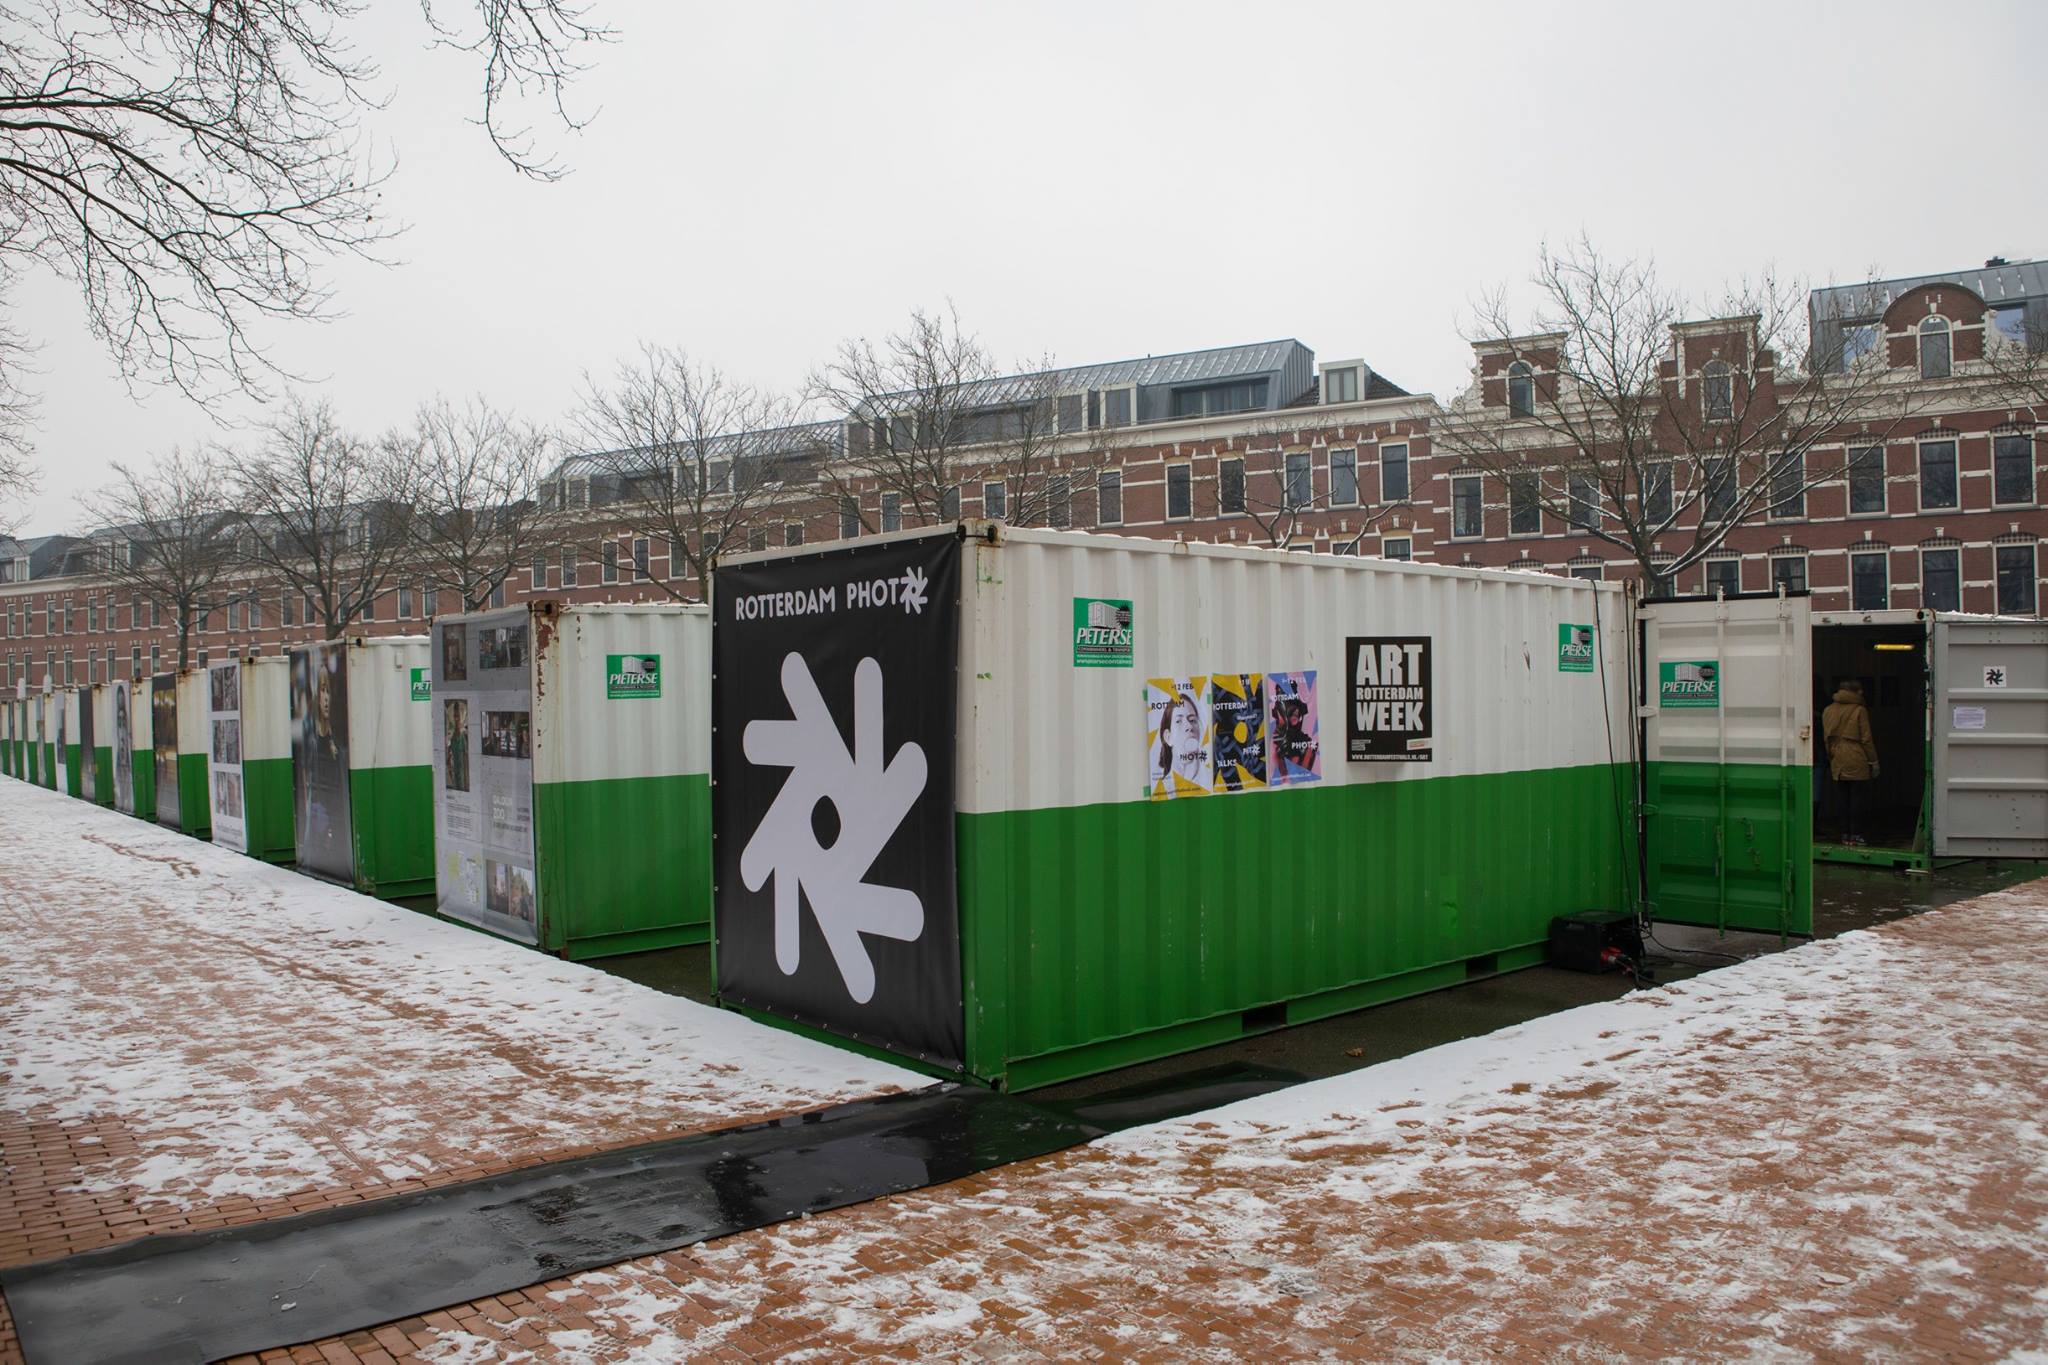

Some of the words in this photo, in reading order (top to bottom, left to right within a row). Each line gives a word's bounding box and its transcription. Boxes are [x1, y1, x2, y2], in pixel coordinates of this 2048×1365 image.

[735, 586, 835, 620] ROTTERDAM
[1356, 644, 1424, 686] ART
[609, 672, 658, 685] PIETERSE
[1662, 680, 1717, 693] PIETERSE
[1356, 687, 1424, 700] ROTTERDAM
[1356, 702, 1424, 731] WEEK
